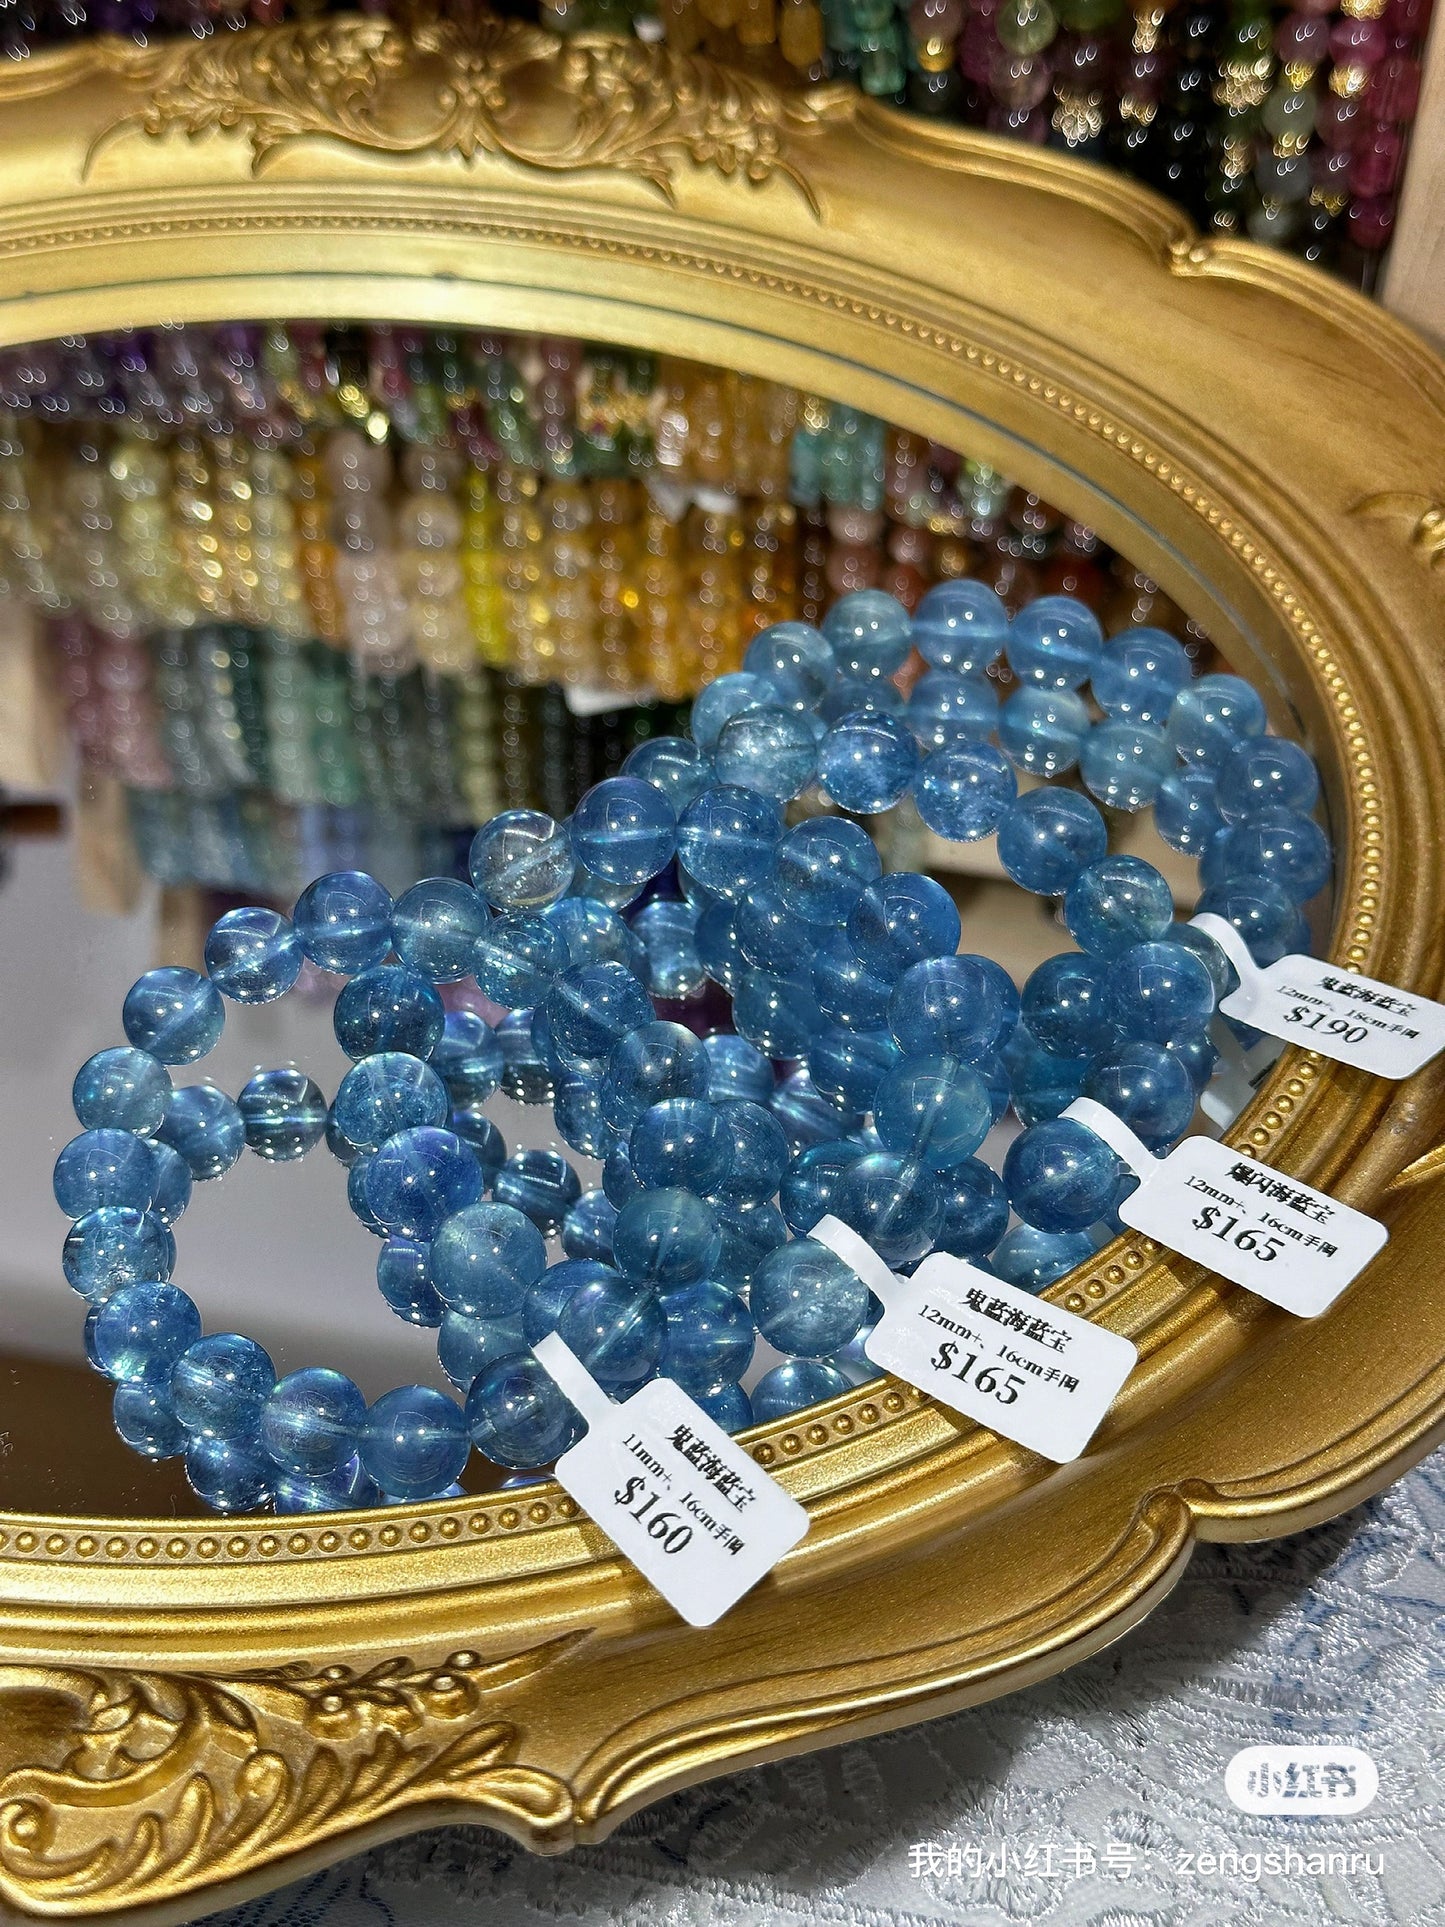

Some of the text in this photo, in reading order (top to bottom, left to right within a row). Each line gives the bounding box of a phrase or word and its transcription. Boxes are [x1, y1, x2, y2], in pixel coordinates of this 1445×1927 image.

[1283, 1006, 1369, 1044] $190
[1225, 1162, 1336, 1224] 爆闪海蓝宝
[1192, 1205, 1286, 1262] $165
[960, 1287, 1073, 1354] 鬼蓝海蓝宝
[931, 1340, 1026, 1405] $165
[666, 1423, 757, 1514] 鬼蓝海蓝宝
[615, 1476, 694, 1555] $160
